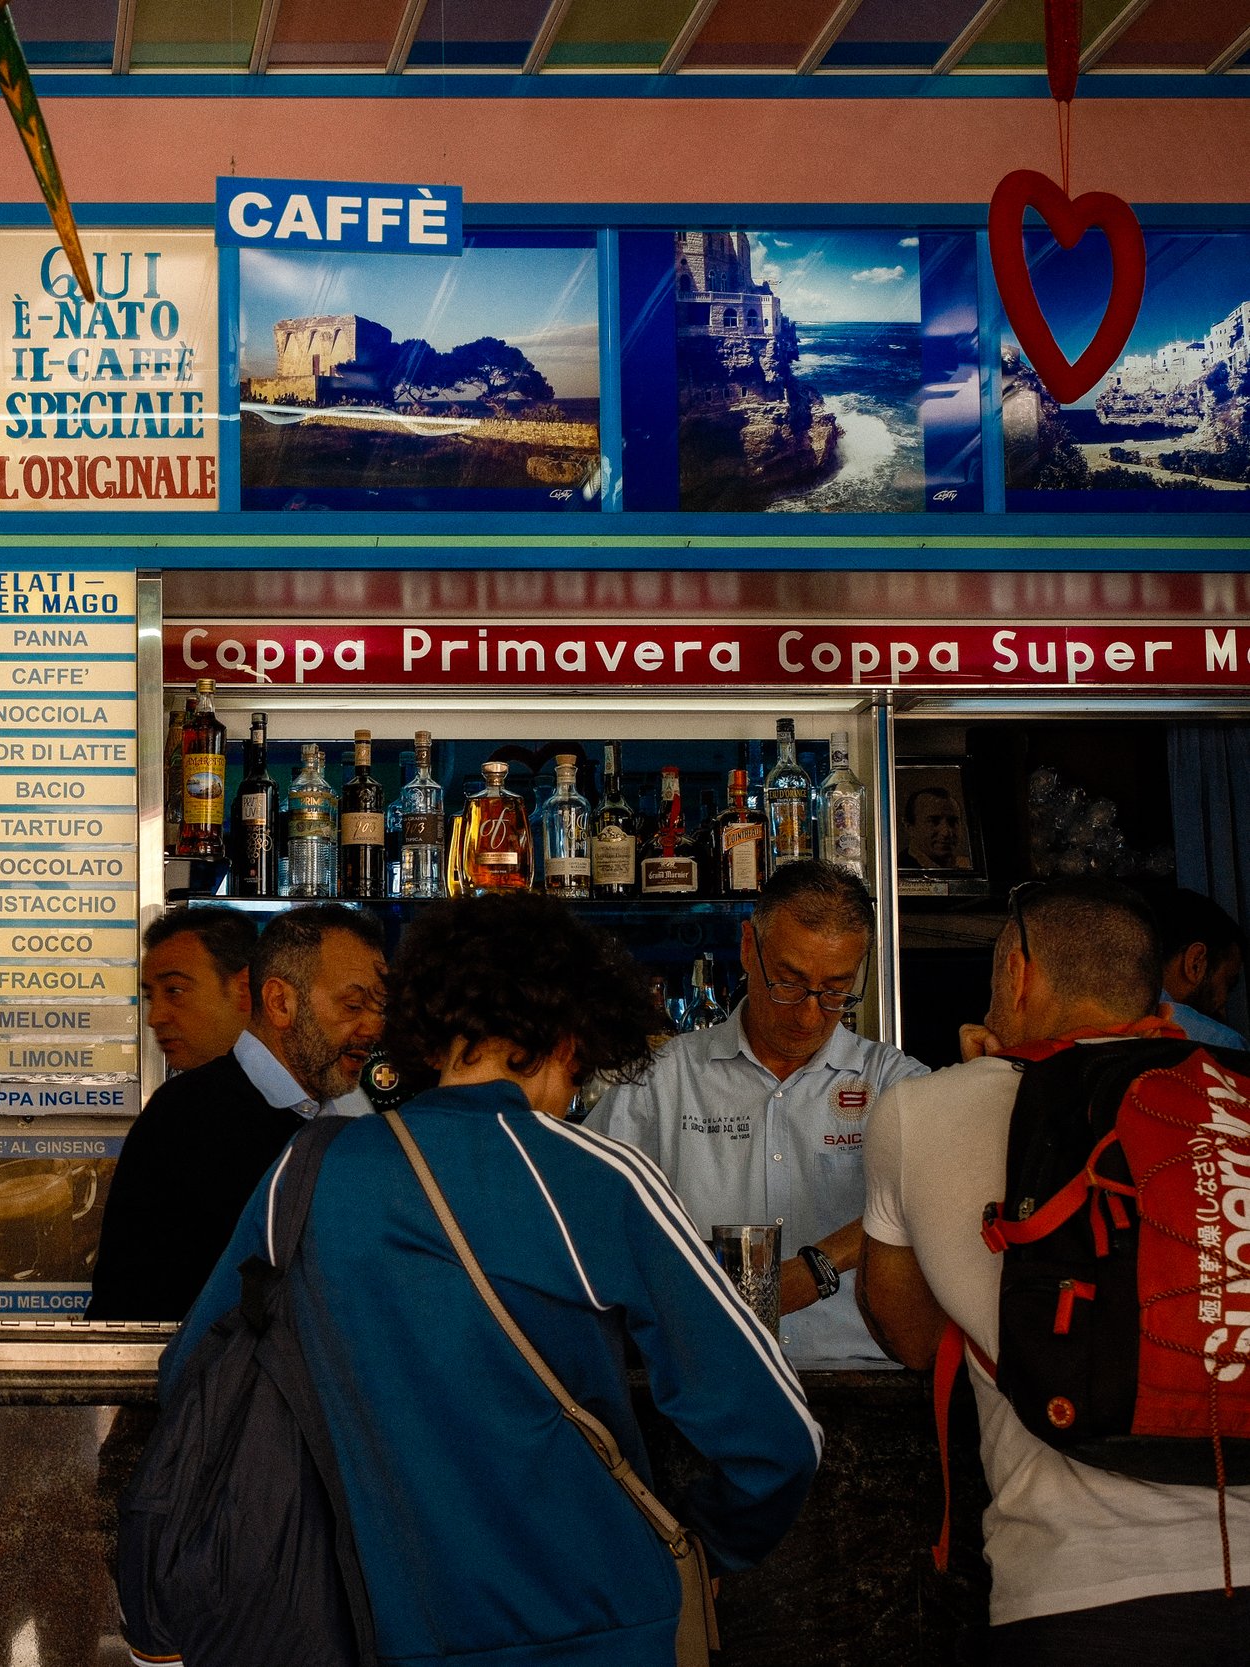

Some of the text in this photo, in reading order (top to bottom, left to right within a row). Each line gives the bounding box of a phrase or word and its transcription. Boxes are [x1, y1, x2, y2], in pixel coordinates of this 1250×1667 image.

[227, 187, 449, 246] CAFFÈ
[40, 245, 162, 300] QUI
[6, 391, 204, 440] SPECIALE
[42, 594, 118, 613] MAGO
[13, 630, 88, 647] PANNA
[182, 628, 1250, 684] Coppa Primavera Coppa Super M
[12, 668, 90, 685] CAFFE'
[32, 744, 52, 760] DI
[60, 744, 127, 760] LATTE
[16, 782, 85, 799] BACIO
[1, 819, 103, 836] TARTUFO
[11, 935, 93, 953] COCCO
[9, 1050, 94, 1067] LIMONE
[39, 1090, 124, 1106] INGLESE
[10, 1140, 30, 1153] AL
[34, 1140, 106, 1154] GINSENG
[823, 1133, 863, 1145] SAIC
